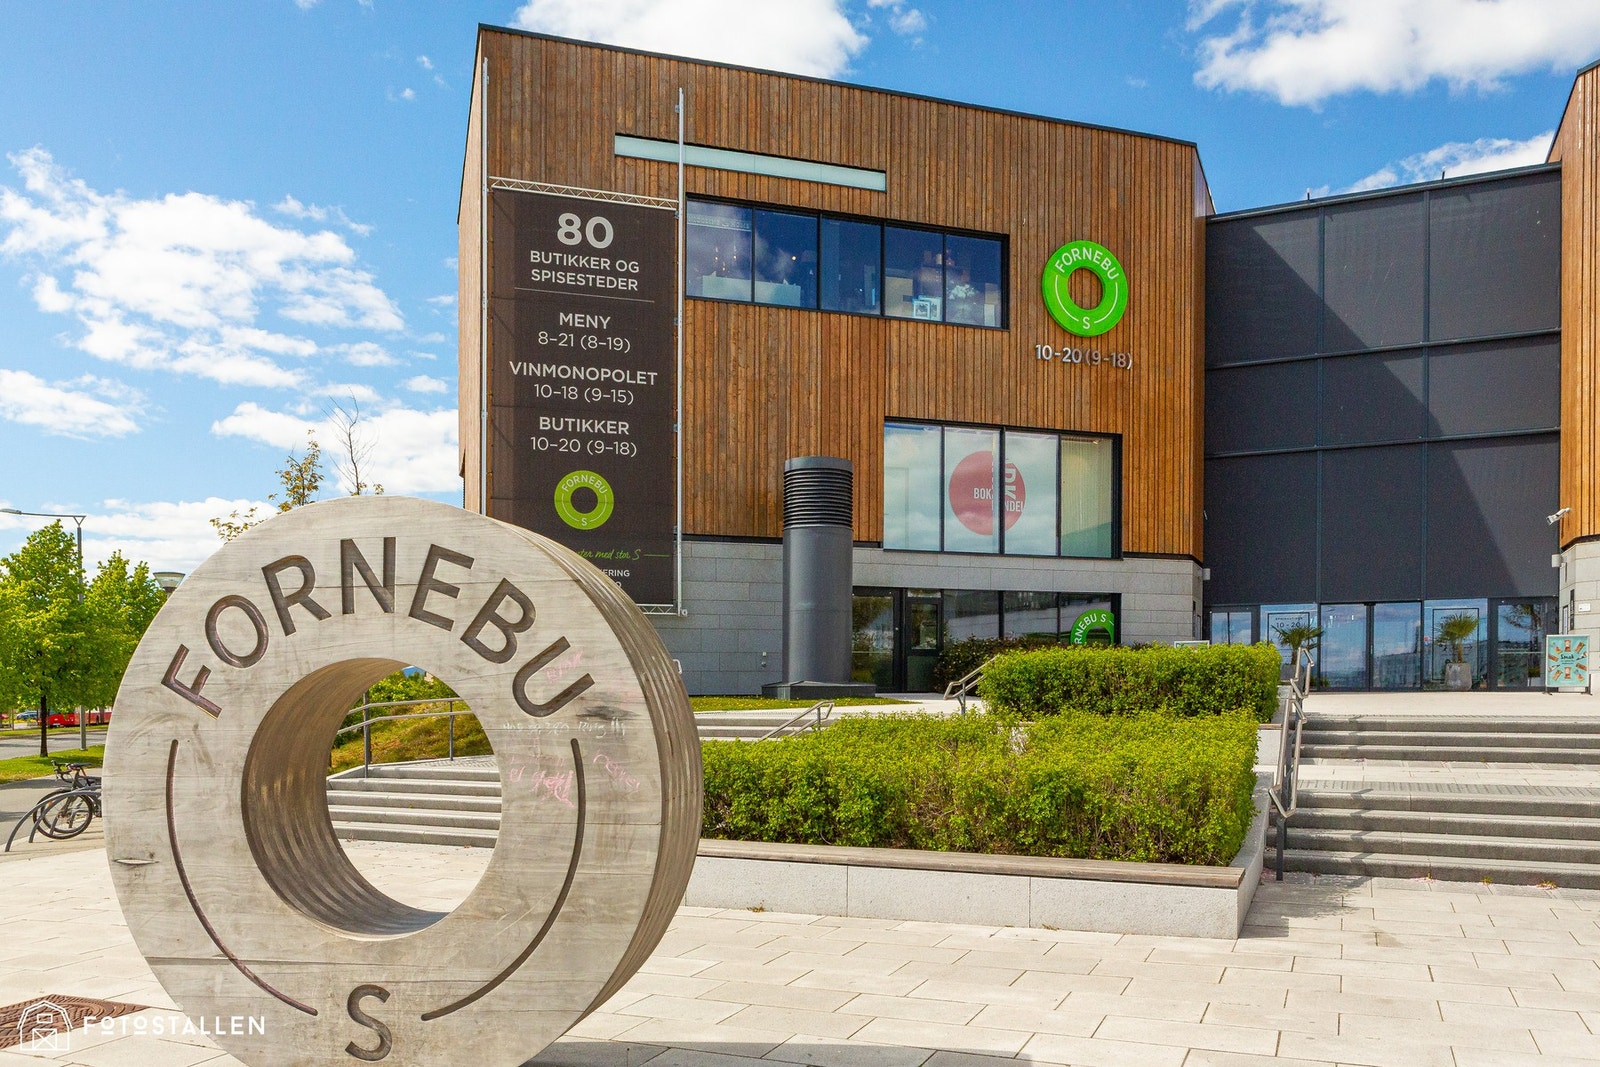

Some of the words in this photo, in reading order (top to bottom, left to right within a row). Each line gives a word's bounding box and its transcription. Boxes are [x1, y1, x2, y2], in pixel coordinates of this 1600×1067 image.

[557, 212, 614, 249] 80
[530, 250, 611, 271] BUTIKKER
[616, 260, 640, 273] OG
[1055, 247, 1119, 280] FORNEBU
[531, 269, 638, 291] SPISESTEDER
[559, 312, 611, 329] MENY
[1082, 316, 1091, 329] S
[509, 361, 658, 386] VINMONOPOLET
[539, 416, 630, 435] BUTIKKER
[561, 474, 608, 494] FORNEBU
[581, 517, 588, 526] S
[594, 548, 615, 559] med
[631, 548, 641, 560] S
[600, 569, 630, 577] ERING
[161, 536, 595, 719] FORNEBU
[1074, 613, 1097, 644] RNEBU
[1100, 613, 1107, 623] S
[346, 984, 392, 1062] S
